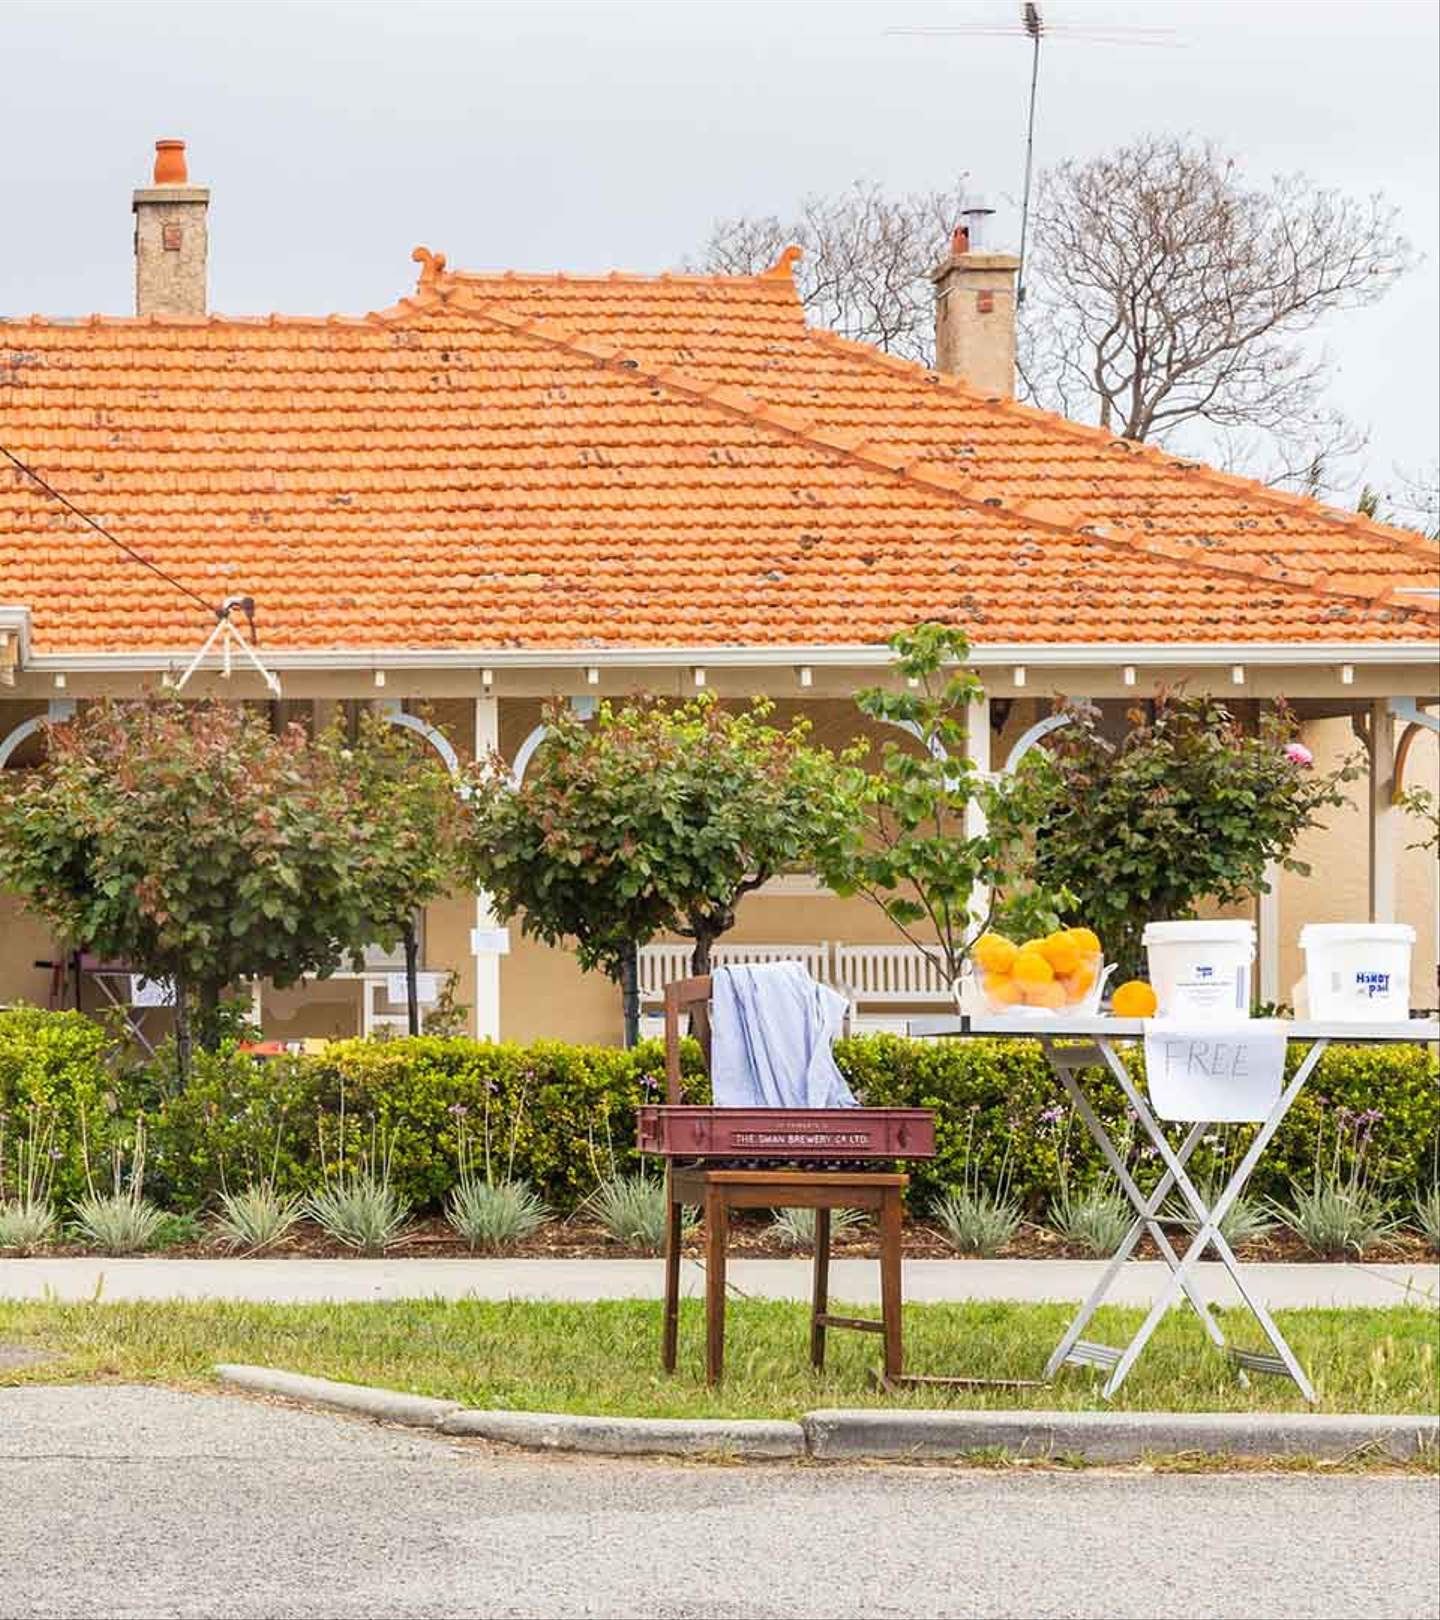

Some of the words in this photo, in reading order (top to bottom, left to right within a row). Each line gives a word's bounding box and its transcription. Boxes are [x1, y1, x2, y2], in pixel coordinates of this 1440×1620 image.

[1163, 1040, 1249, 1077] FREE
[736, 1134, 754, 1144] THE
[758, 1134, 785, 1144] SWAN
[787, 1134, 832, 1144] BREWERY
